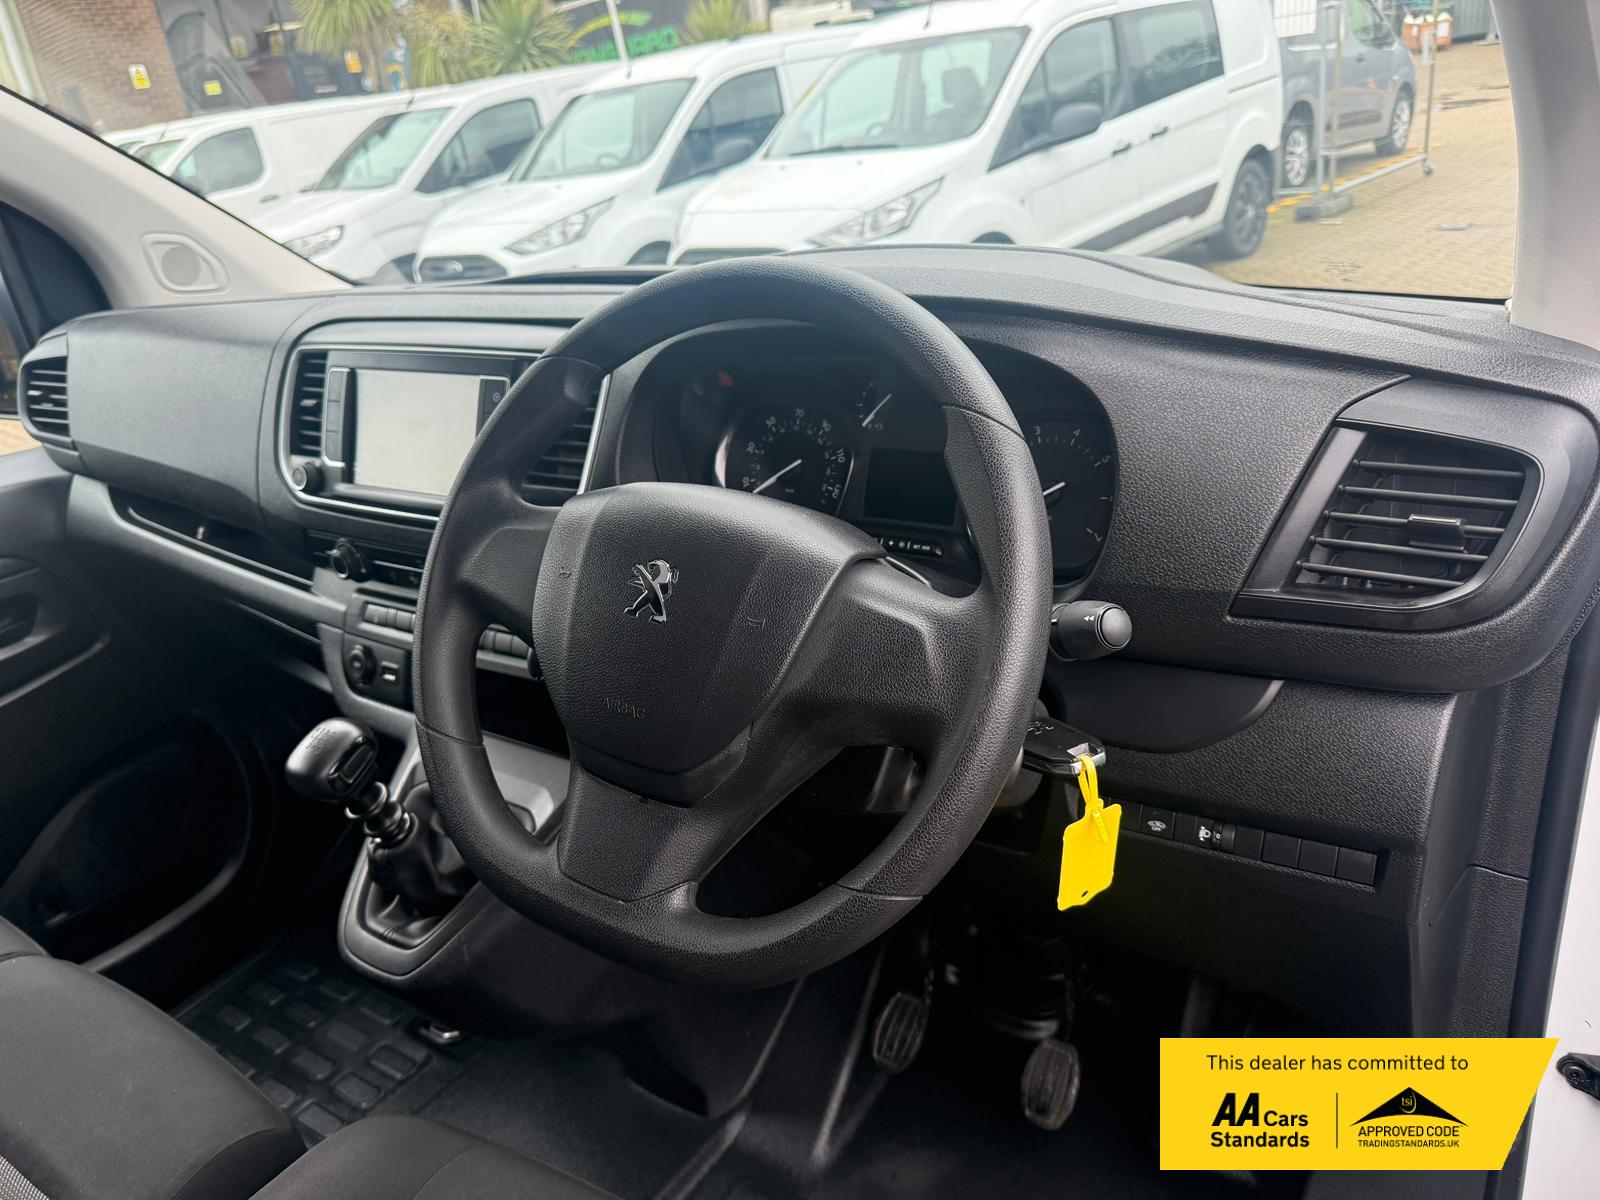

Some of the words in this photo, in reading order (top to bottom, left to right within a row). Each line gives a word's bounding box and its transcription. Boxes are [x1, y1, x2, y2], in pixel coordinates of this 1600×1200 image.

[794, 408, 805, 418] 70
[1034, 425, 1041, 435] 3
[1073, 429, 1081, 437] 4
[836, 448, 845, 463] 110
